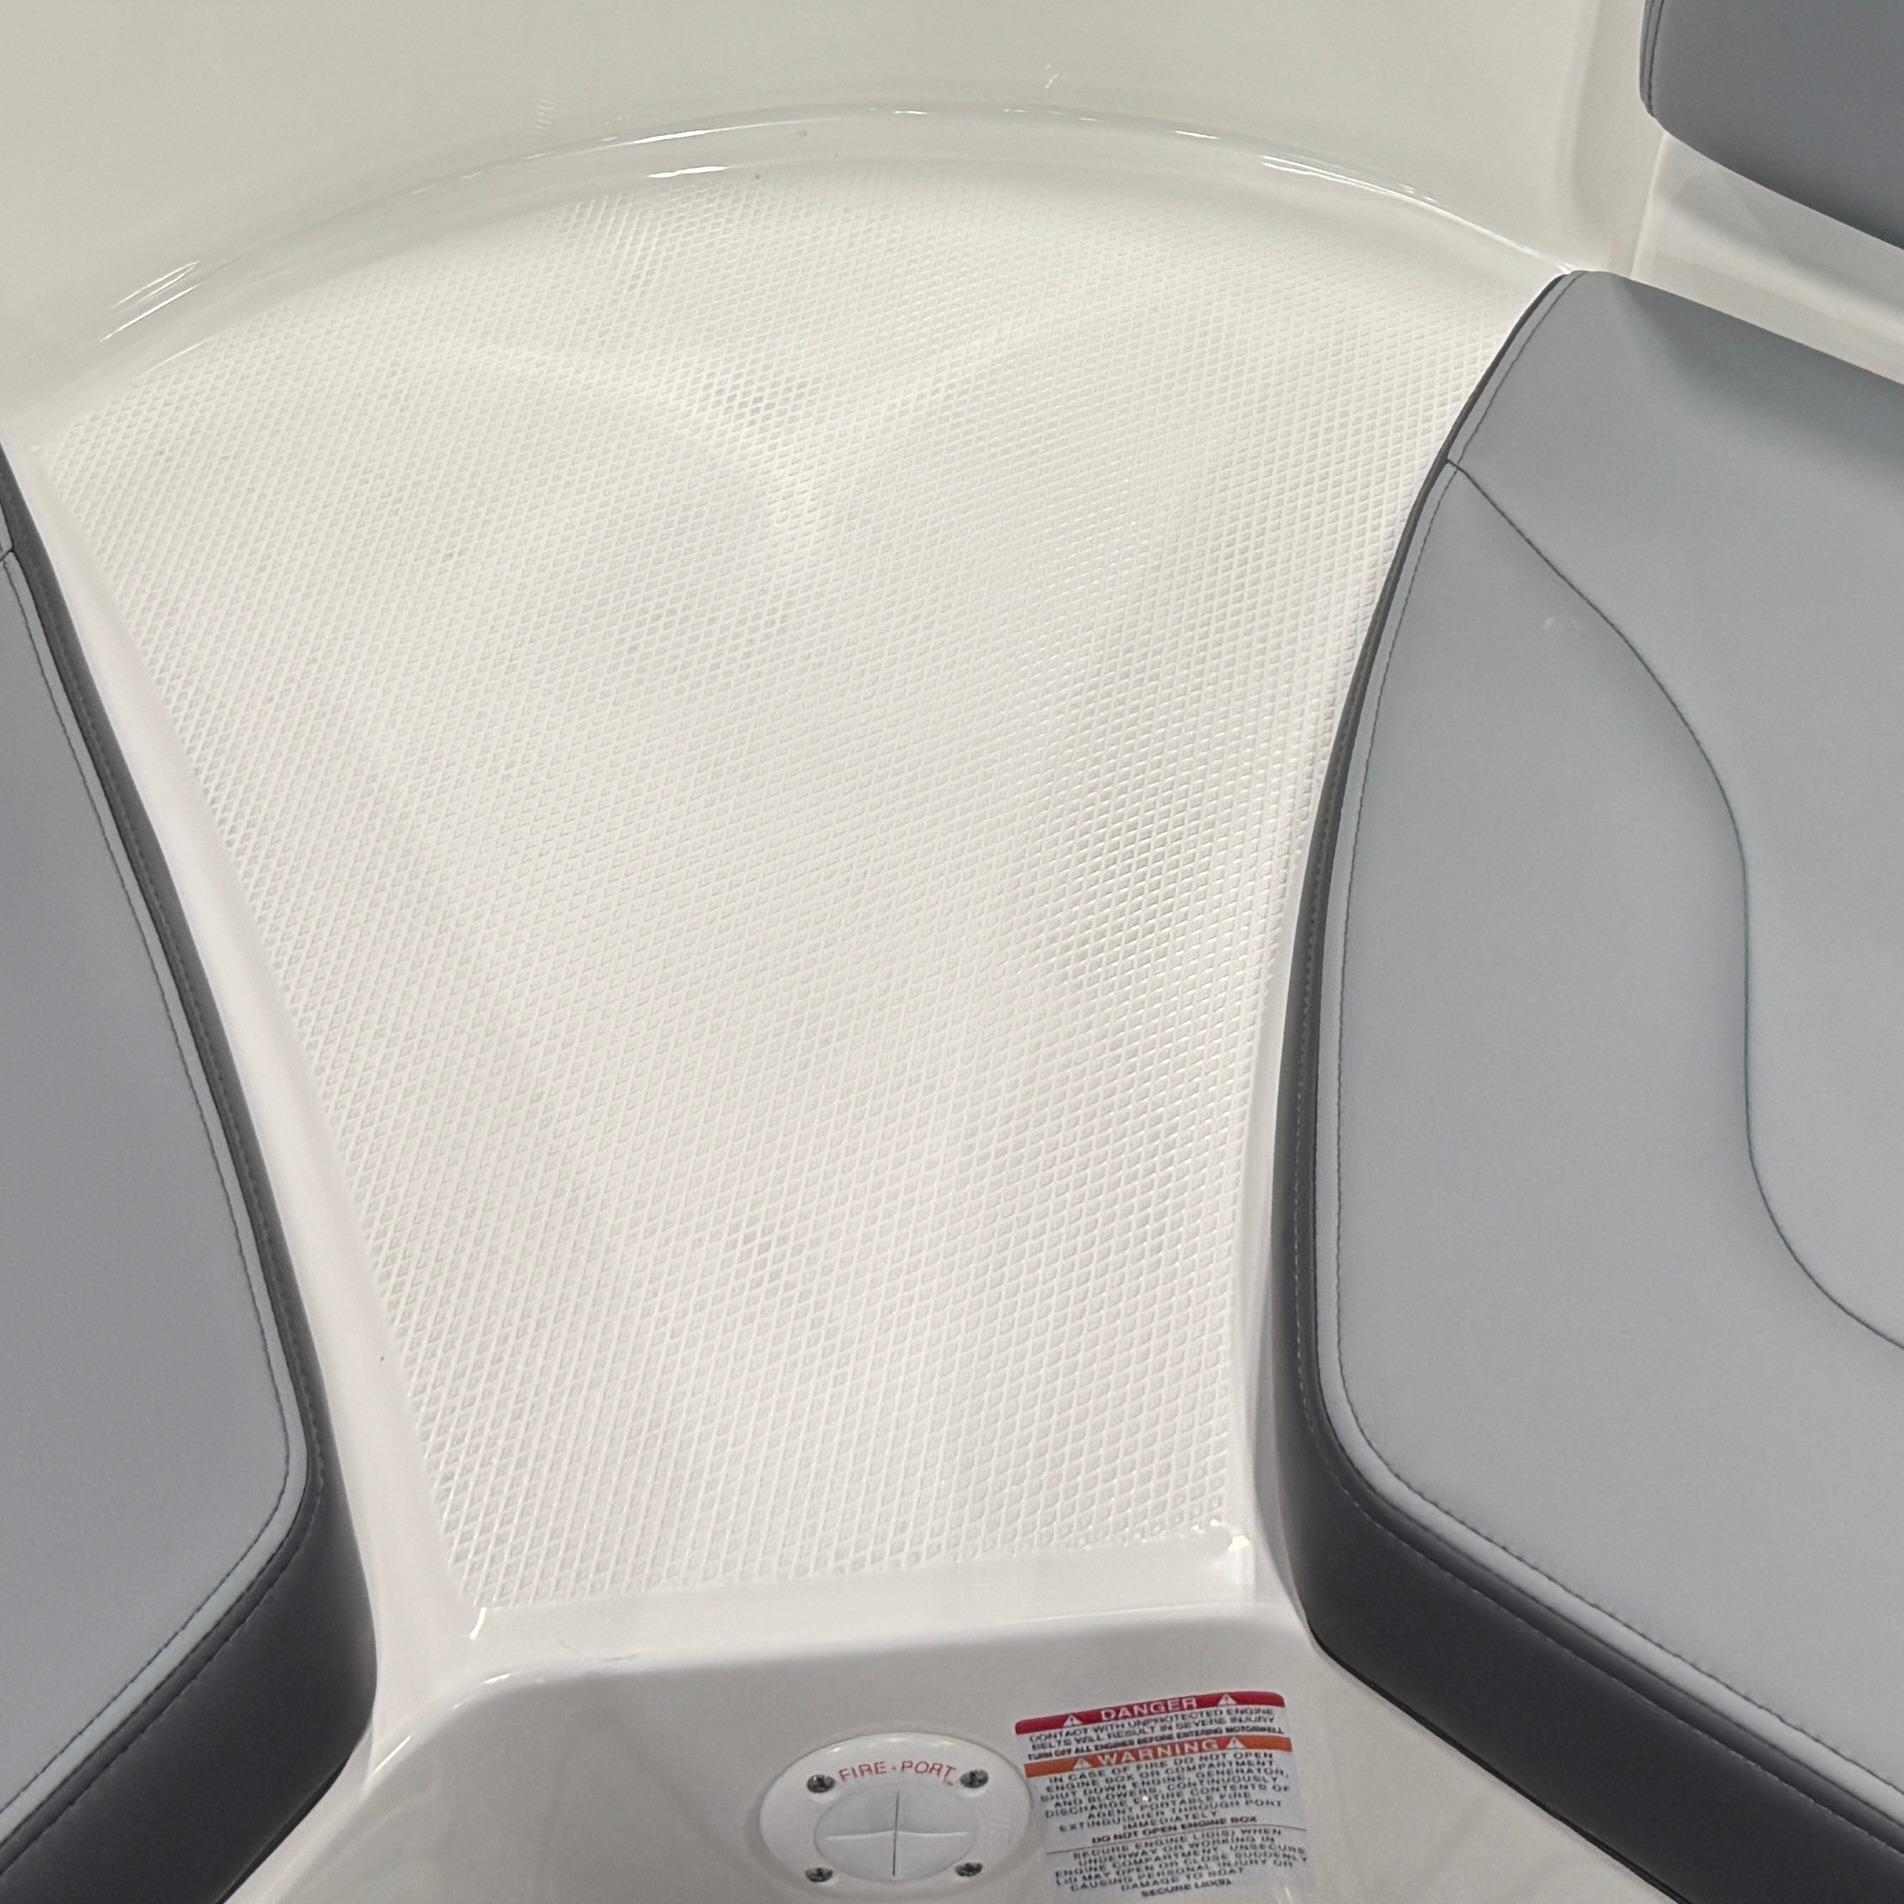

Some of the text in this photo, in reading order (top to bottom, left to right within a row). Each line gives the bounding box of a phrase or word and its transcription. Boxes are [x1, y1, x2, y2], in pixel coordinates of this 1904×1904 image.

[1100, 1698, 1196, 1720] DANGER
[1092, 1721, 1125, 1733] WITH
[1176, 1717, 1226, 1729] SEVERE
[1097, 1739, 1218, 1765] WARNING
[1046, 1778, 1098, 1793] ENGINE
[1139, 1769, 1160, 1778] OR
[1165, 1759, 1273, 1774] COMPARTMENT
[1068, 1769, 1104, 1781] CASE
[1111, 1765, 1129, 1774] OF
[1136, 1759, 1167, 1770] FIRE
[1173, 1756, 1194, 1765] DO
[1198, 1753, 1226, 1762] NOT
[1233, 1751, 1272, 1759] OPEN
[1045, 1797, 1126, 1818] DISCHARGE
[1190, 1783, 1266, 1795] CONTENTS
[1054, 1797, 1083, 1808] AND
[1167, 1775, 1276, 1790] CONTINUOUSLY
[1083, 1782, 1126, 1796] DOWN
[1059, 1807, 1165, 1833] EXTINGUISHER
[1088, 1806, 1134, 1820] AGENT
[1140, 1794, 1213, 1812] PORTABLE
[1123, 1809, 1217, 1831] IMMEDIATELY
[1092, 1815, 1257, 1844] DO NOT OPEN ENGINE BOX
[1134, 1834, 1186, 1850] ENGINE
[1240, 1827, 1281, 1835] WHEN
[1078, 1846, 1156, 1867] UNDERWAY
[1188, 1836, 1256, 1849] WORKING
[1055, 1862, 1108, 1878] ENGINE
[1070, 1874, 1134, 1892] CAUSING
[1137, 1863, 1209, 1881] PERSONAL
[1082, 1870, 1110, 1882] MAY
[1116, 1863, 1154, 1876] OPEN
[1183, 1852, 1228, 1865] CLOSE
[1121, 1874, 1180, 1892] DAMAGE
[1140, 1882, 1191, 1898] SECURE
